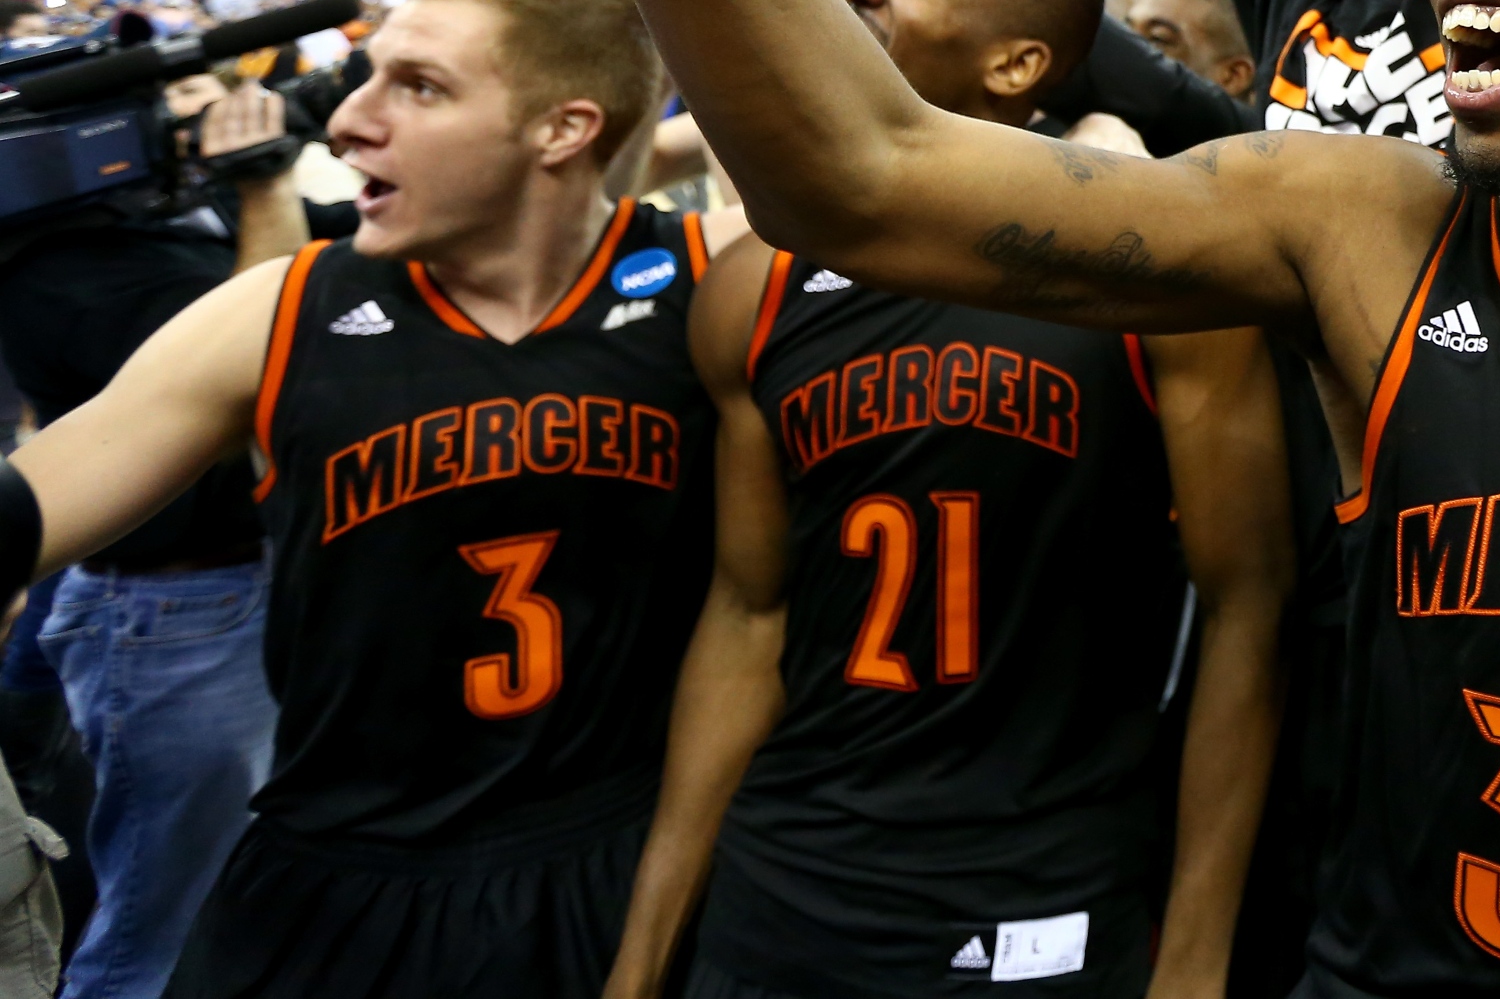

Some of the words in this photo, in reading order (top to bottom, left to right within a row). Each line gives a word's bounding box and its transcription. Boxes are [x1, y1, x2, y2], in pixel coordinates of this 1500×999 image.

[780, 340, 1081, 473] MERCER
[1418, 325, 1489, 353] adidas
[320, 392, 682, 546] MERCER
[457, 529, 563, 720] 3
[840, 490, 980, 692] 21
